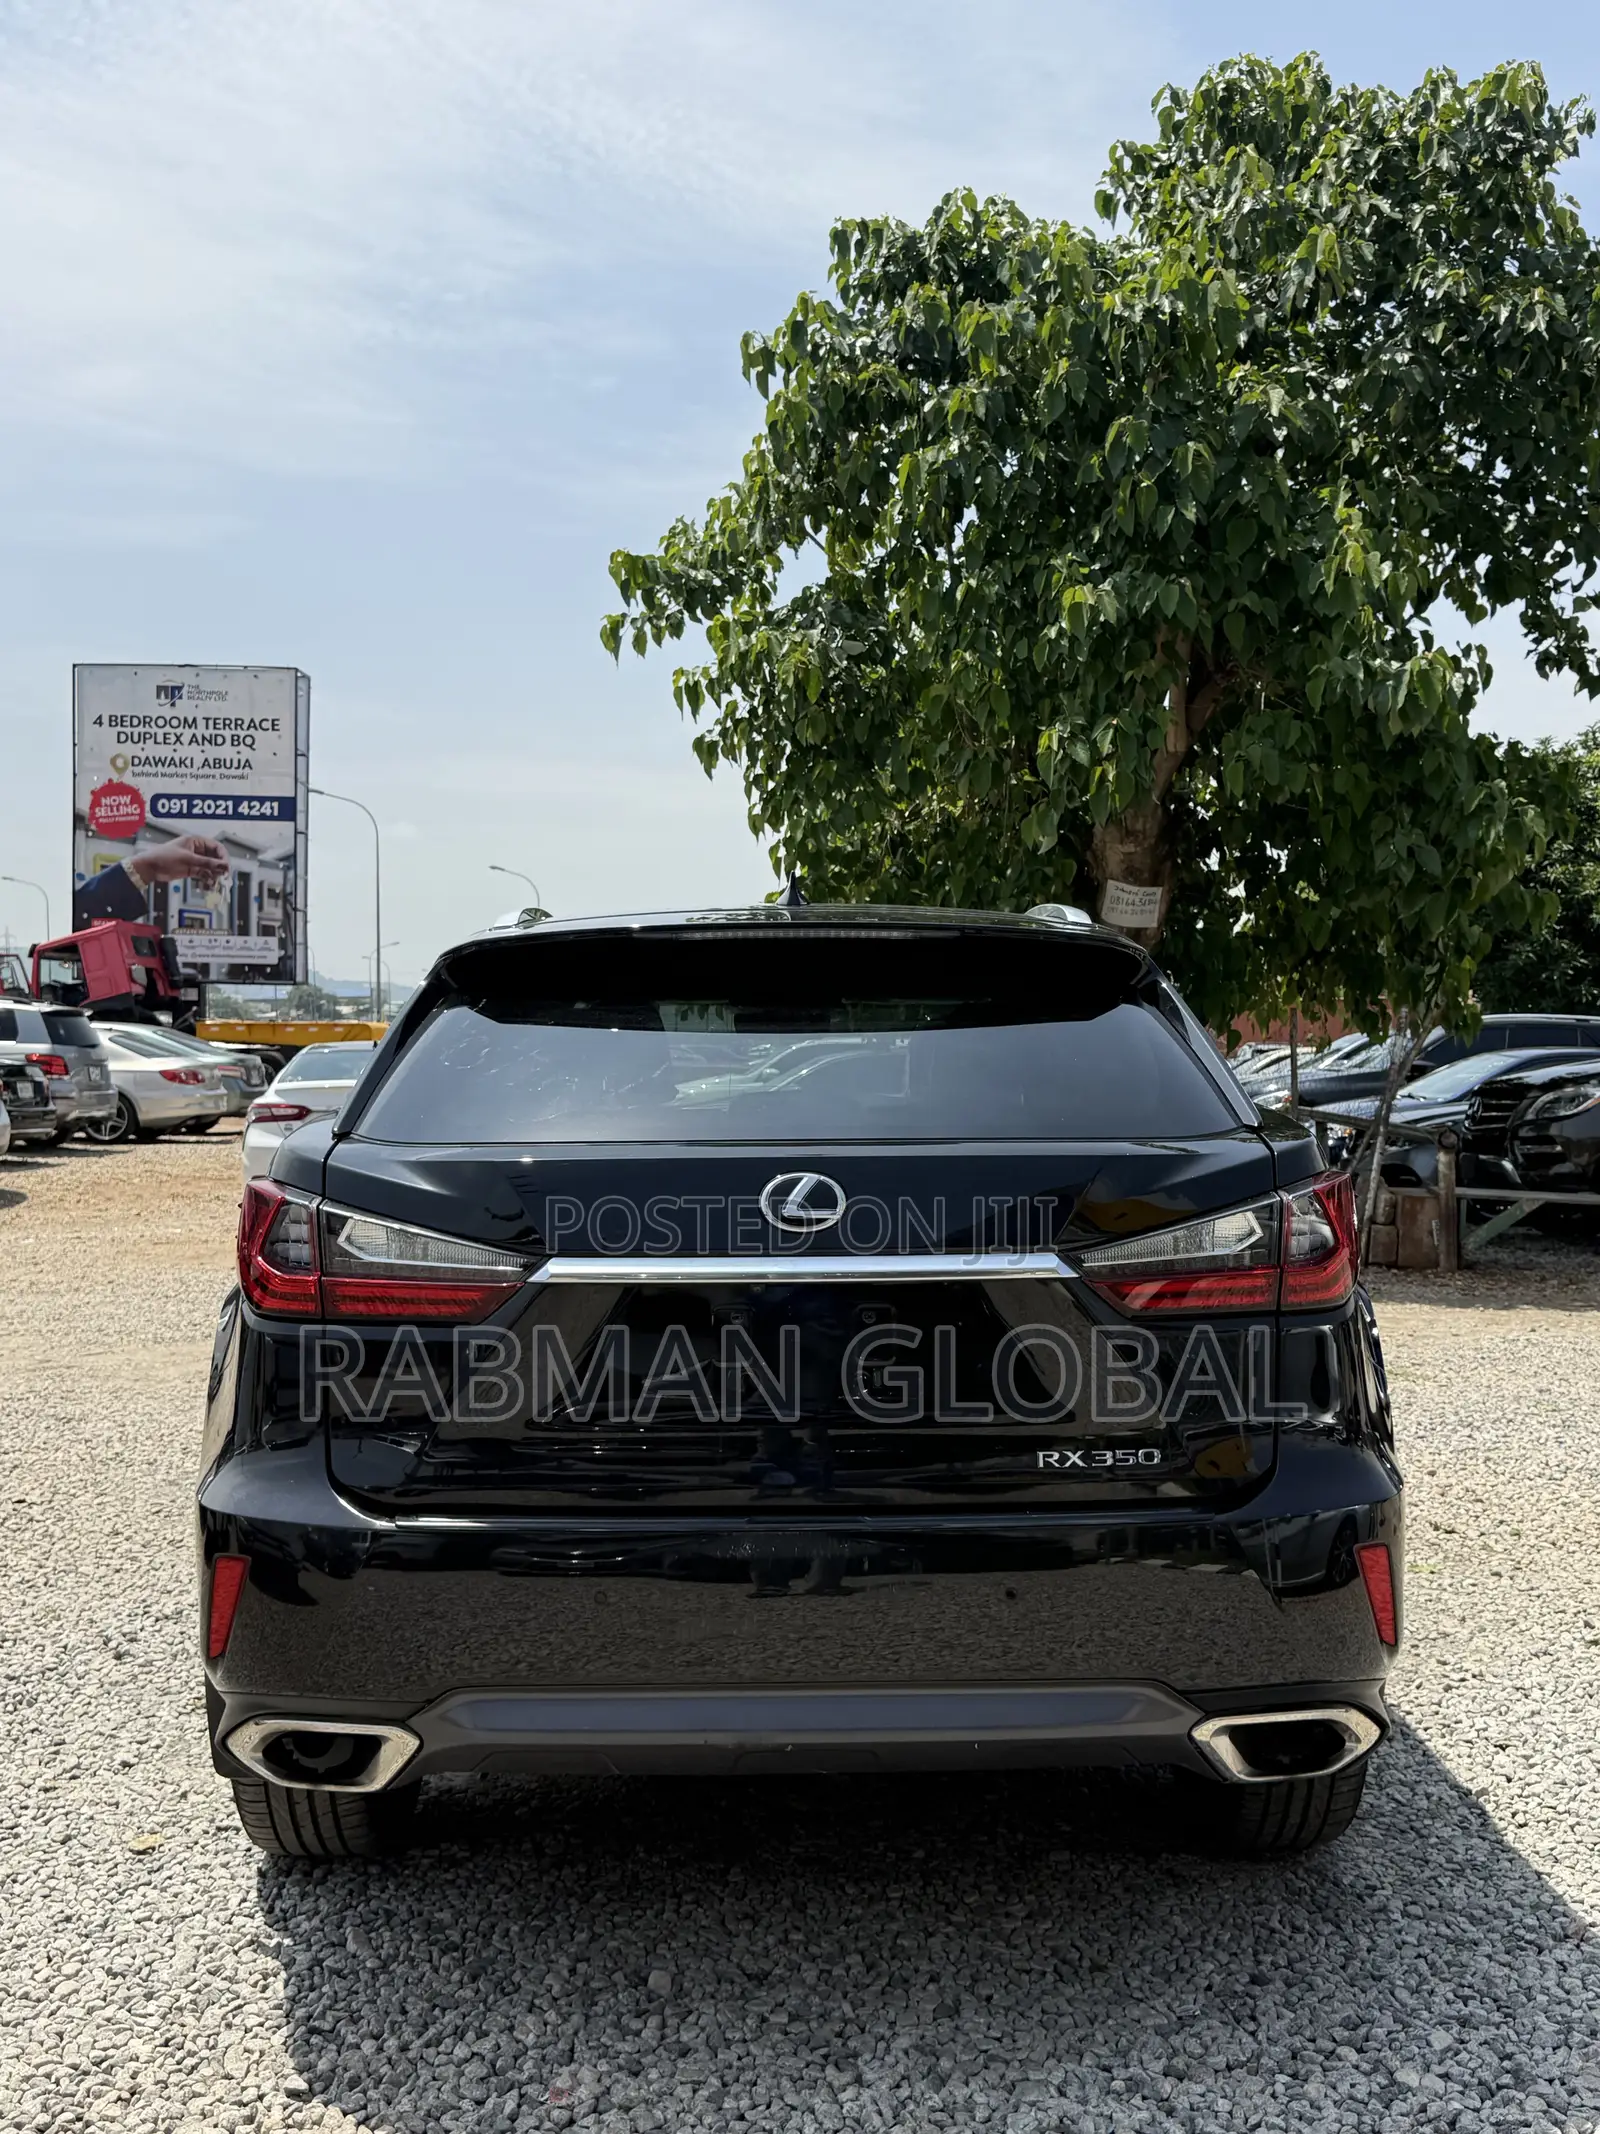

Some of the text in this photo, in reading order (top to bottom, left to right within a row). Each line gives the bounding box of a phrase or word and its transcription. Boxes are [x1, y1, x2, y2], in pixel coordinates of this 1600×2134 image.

[92, 714, 281, 732] 4 BEDROOM TERRACE
[116, 731, 256, 751] DUPLEX AND BQ
[131, 755, 194, 769] DAWAKI
[131, 770, 159, 778] behind
[160, 771, 188, 779] Market
[101, 794, 132, 806] NOW
[157, 798, 279, 817] 091 2021 4241
[95, 804, 140, 818] SELLING
[1036, 1448, 1162, 1468] RX 350
